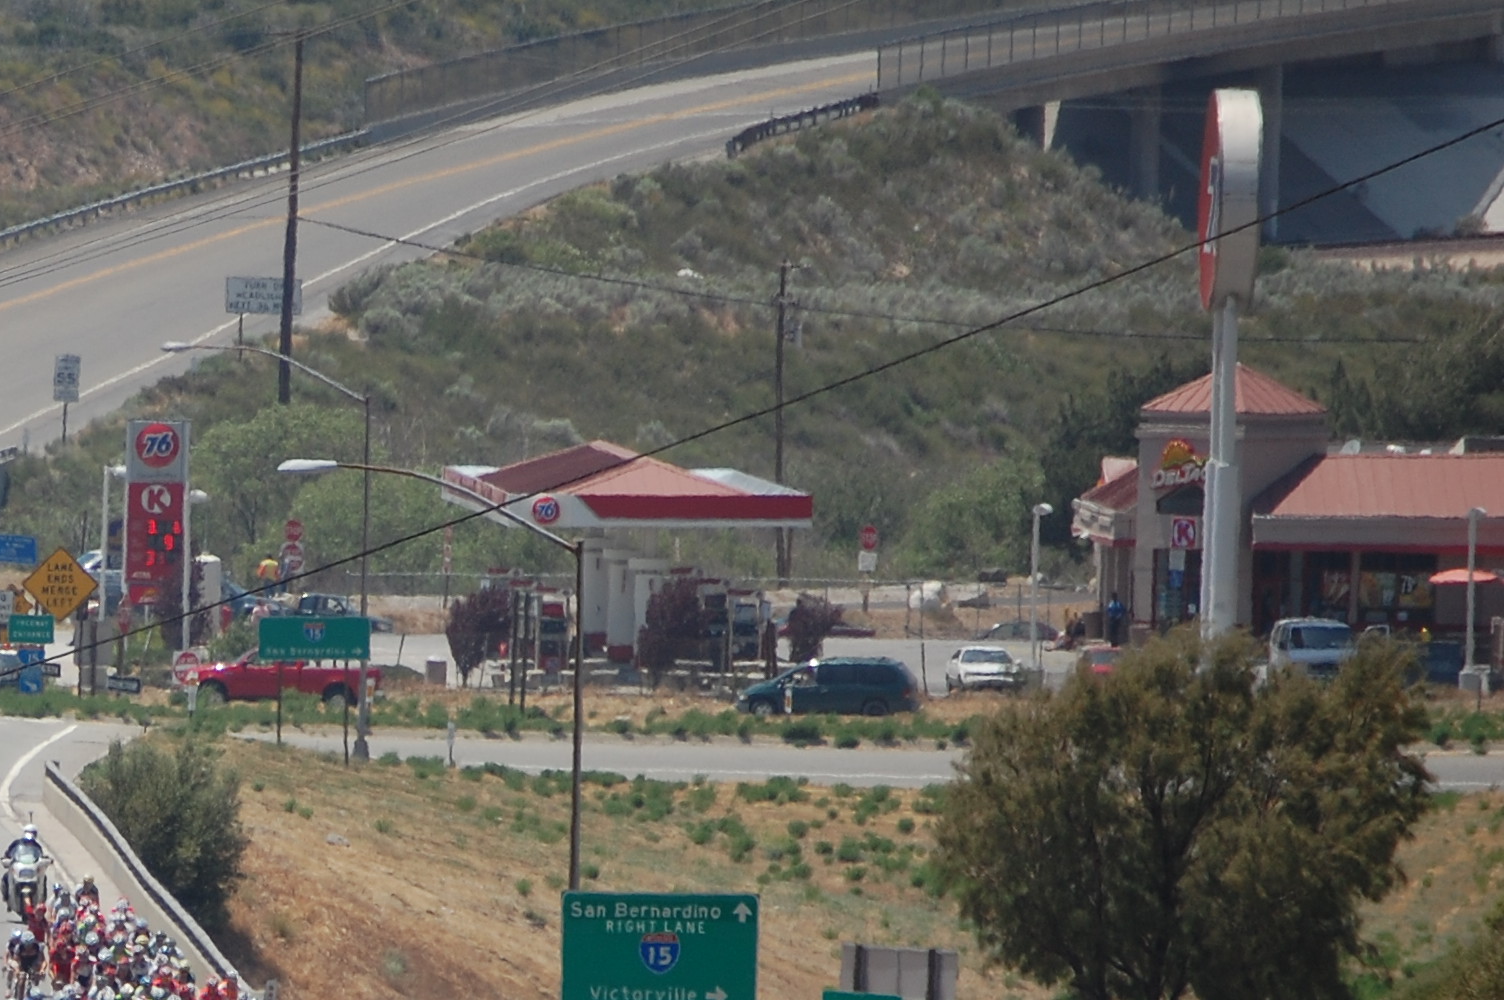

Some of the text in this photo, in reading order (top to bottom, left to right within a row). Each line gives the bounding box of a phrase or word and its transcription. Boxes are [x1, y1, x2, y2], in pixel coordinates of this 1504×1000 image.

[236, 291, 284, 300] HEADLIGH
[56, 372, 76, 385] 55
[142, 432, 173, 458] 76
[537, 502, 556, 519] 76
[1175, 522, 1194, 546] K
[48, 563, 73, 572] LANE
[48, 574, 74, 583] ENDS
[42, 585, 77, 595] MERGE
[46, 597, 72, 609] LEFT
[309, 627, 322, 639] 15
[265, 646, 347, 657] San Bernardino
[571, 902, 722, 919] San Bernardino
[606, 920, 706, 934] RIGHT LANE
[648, 946, 673, 965] 15
